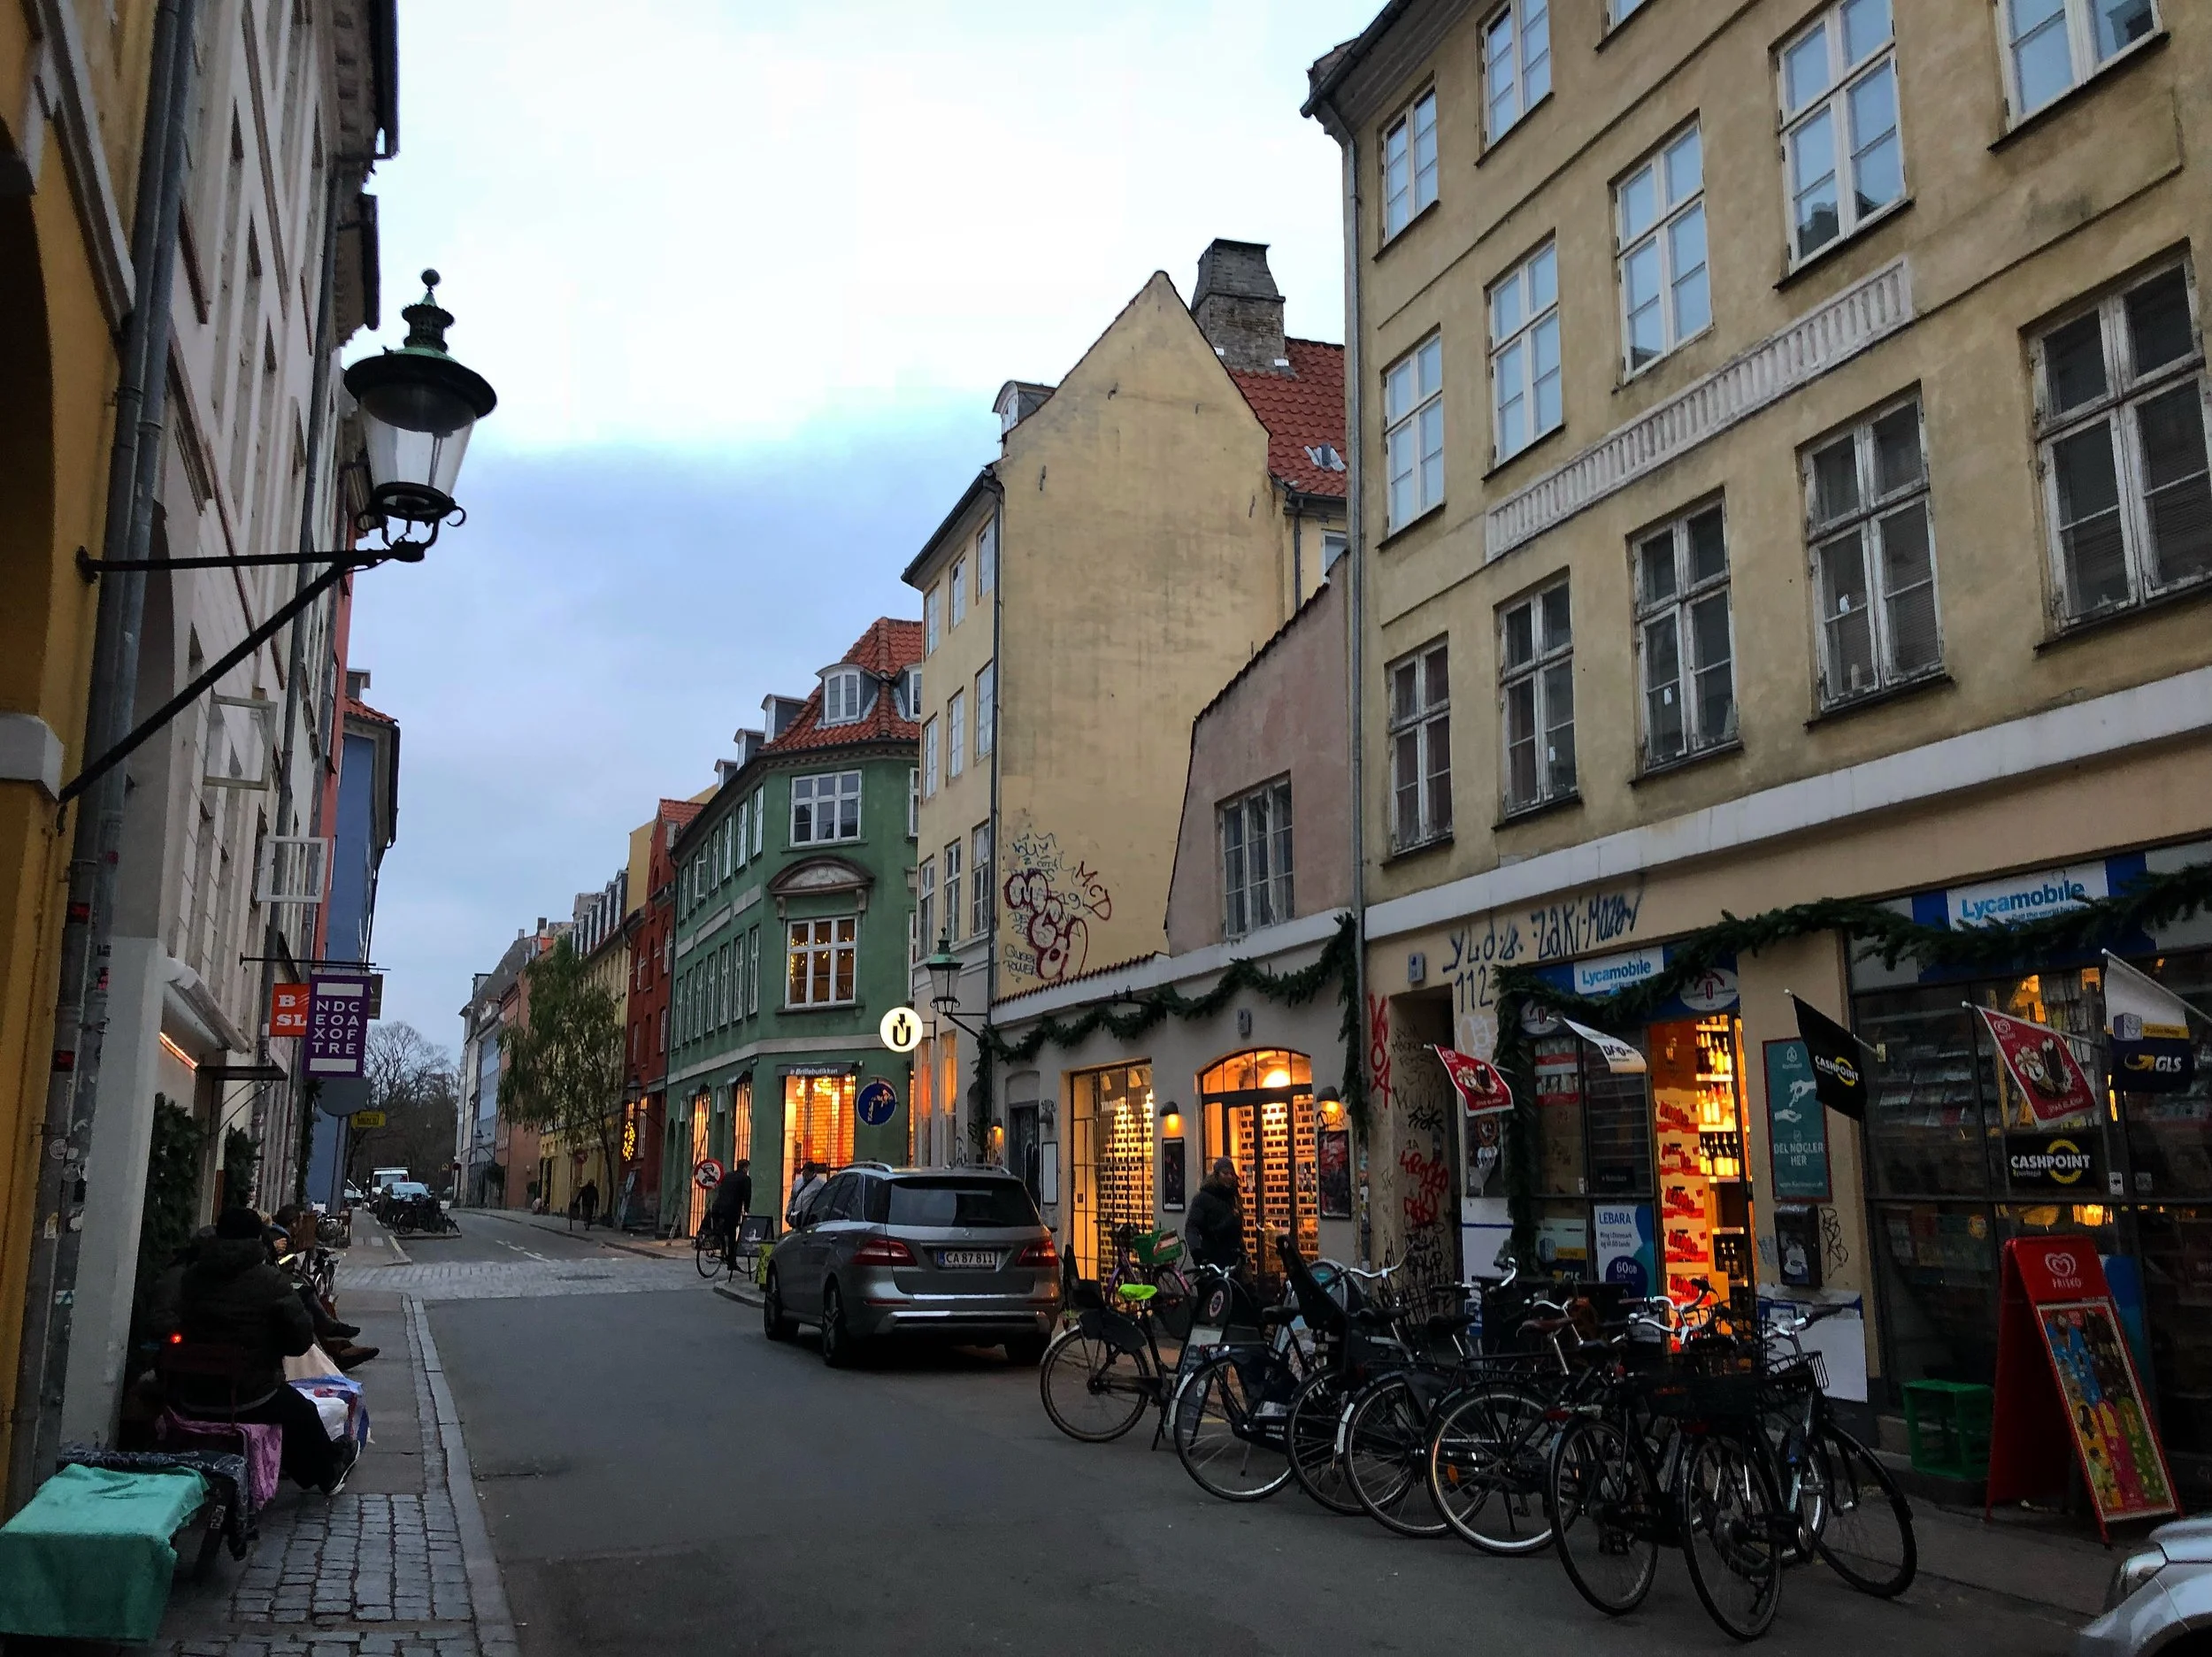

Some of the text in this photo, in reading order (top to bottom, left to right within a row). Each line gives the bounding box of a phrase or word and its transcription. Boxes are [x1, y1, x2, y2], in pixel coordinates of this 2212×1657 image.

[1961, 879, 2085, 921] Lycamobile
[1582, 960, 1651, 986] Lycamobile
[1455, 965, 1494, 1013] 112
[1815, 1055, 1860, 1082] CASHPOINT
[2155, 1055, 2182, 1073] GLS
[1790, 1155, 1808, 1166] HER
[2010, 1154, 2091, 1170] CASHPOINT
[1599, 1212, 1632, 1224] LEBARA
[946, 1253, 993, 1263] CA 87 811
